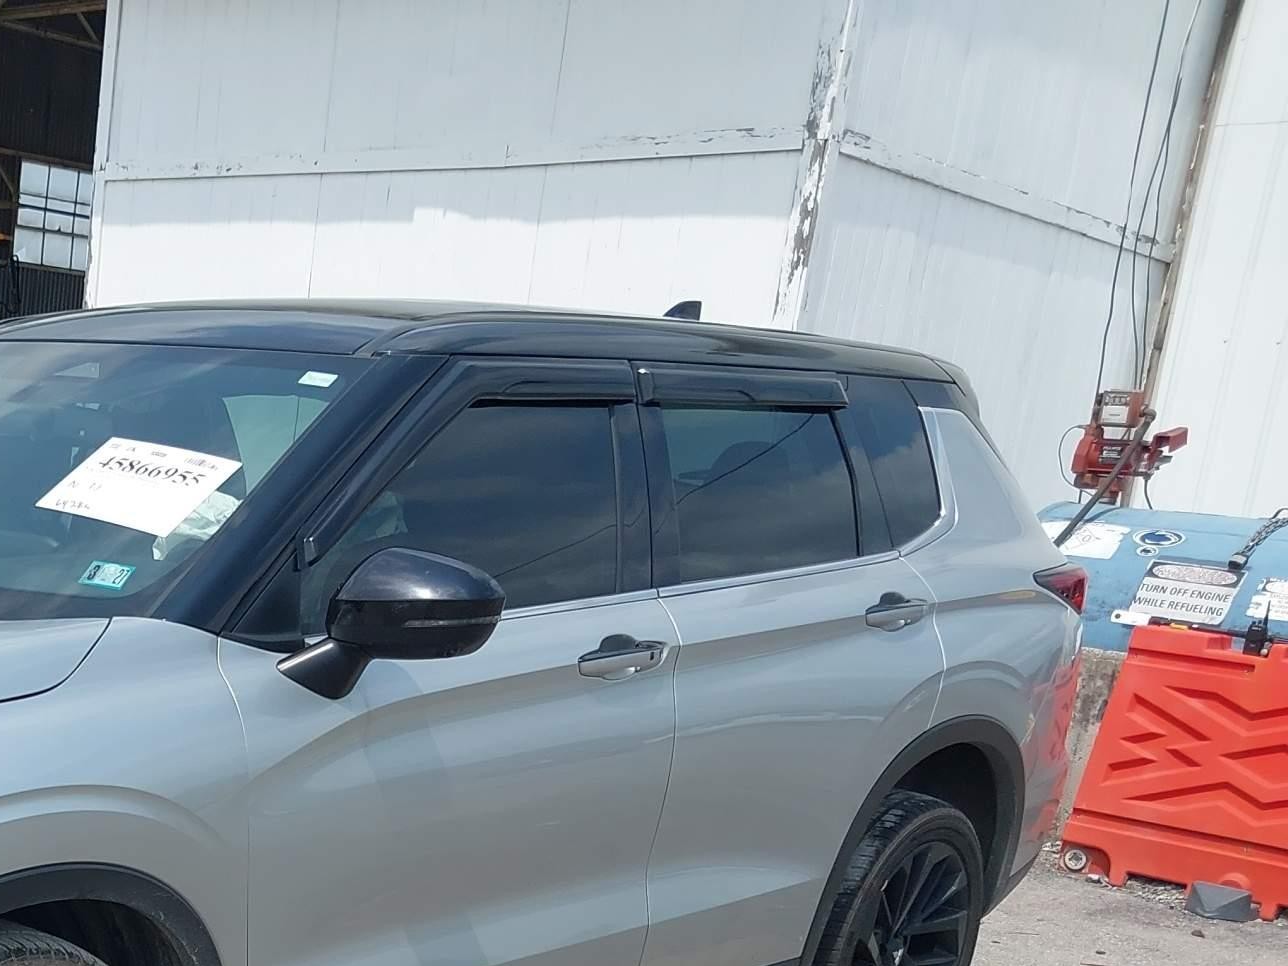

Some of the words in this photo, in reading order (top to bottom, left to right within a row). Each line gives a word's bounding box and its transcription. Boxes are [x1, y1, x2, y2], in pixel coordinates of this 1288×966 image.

[99, 456, 207, 487] 45866955
[87, 564, 101, 580] 3
[112, 568, 130, 585] 27
[1141, 583, 1167, 595] TURN
[1169, 588, 1189, 597] OFF
[1190, 589, 1232, 603] ENGINE
[1133, 596, 1166, 608] WHILE
[1167, 600, 1224, 617] REFUELING
